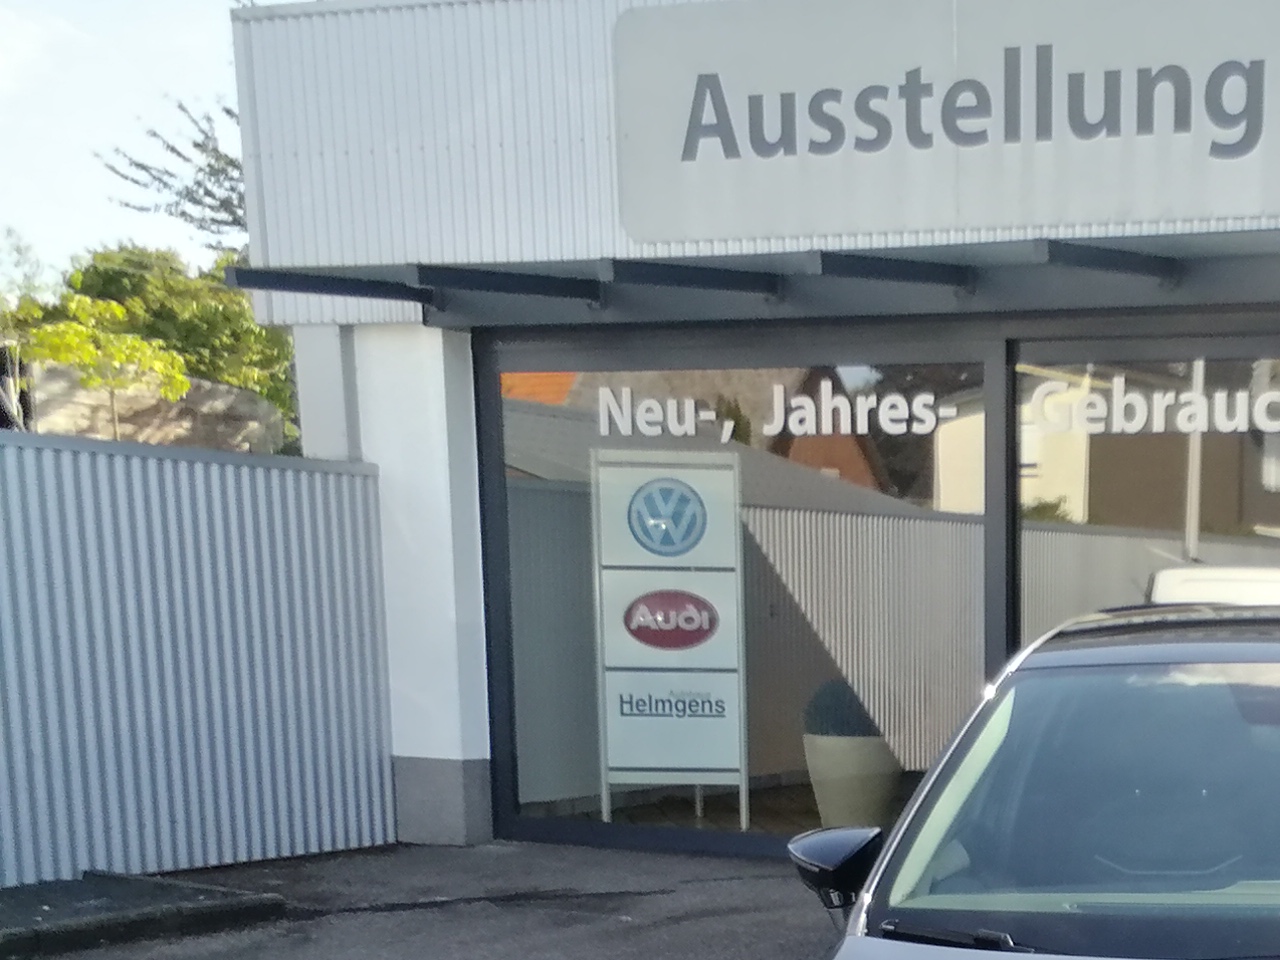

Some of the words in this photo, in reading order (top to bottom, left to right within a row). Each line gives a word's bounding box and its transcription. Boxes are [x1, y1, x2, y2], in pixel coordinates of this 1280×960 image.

[681, 44, 1266, 161] Ausstellung
[762, 378, 958, 437] Jahres-
[619, 693, 727, 718] Helmgens
